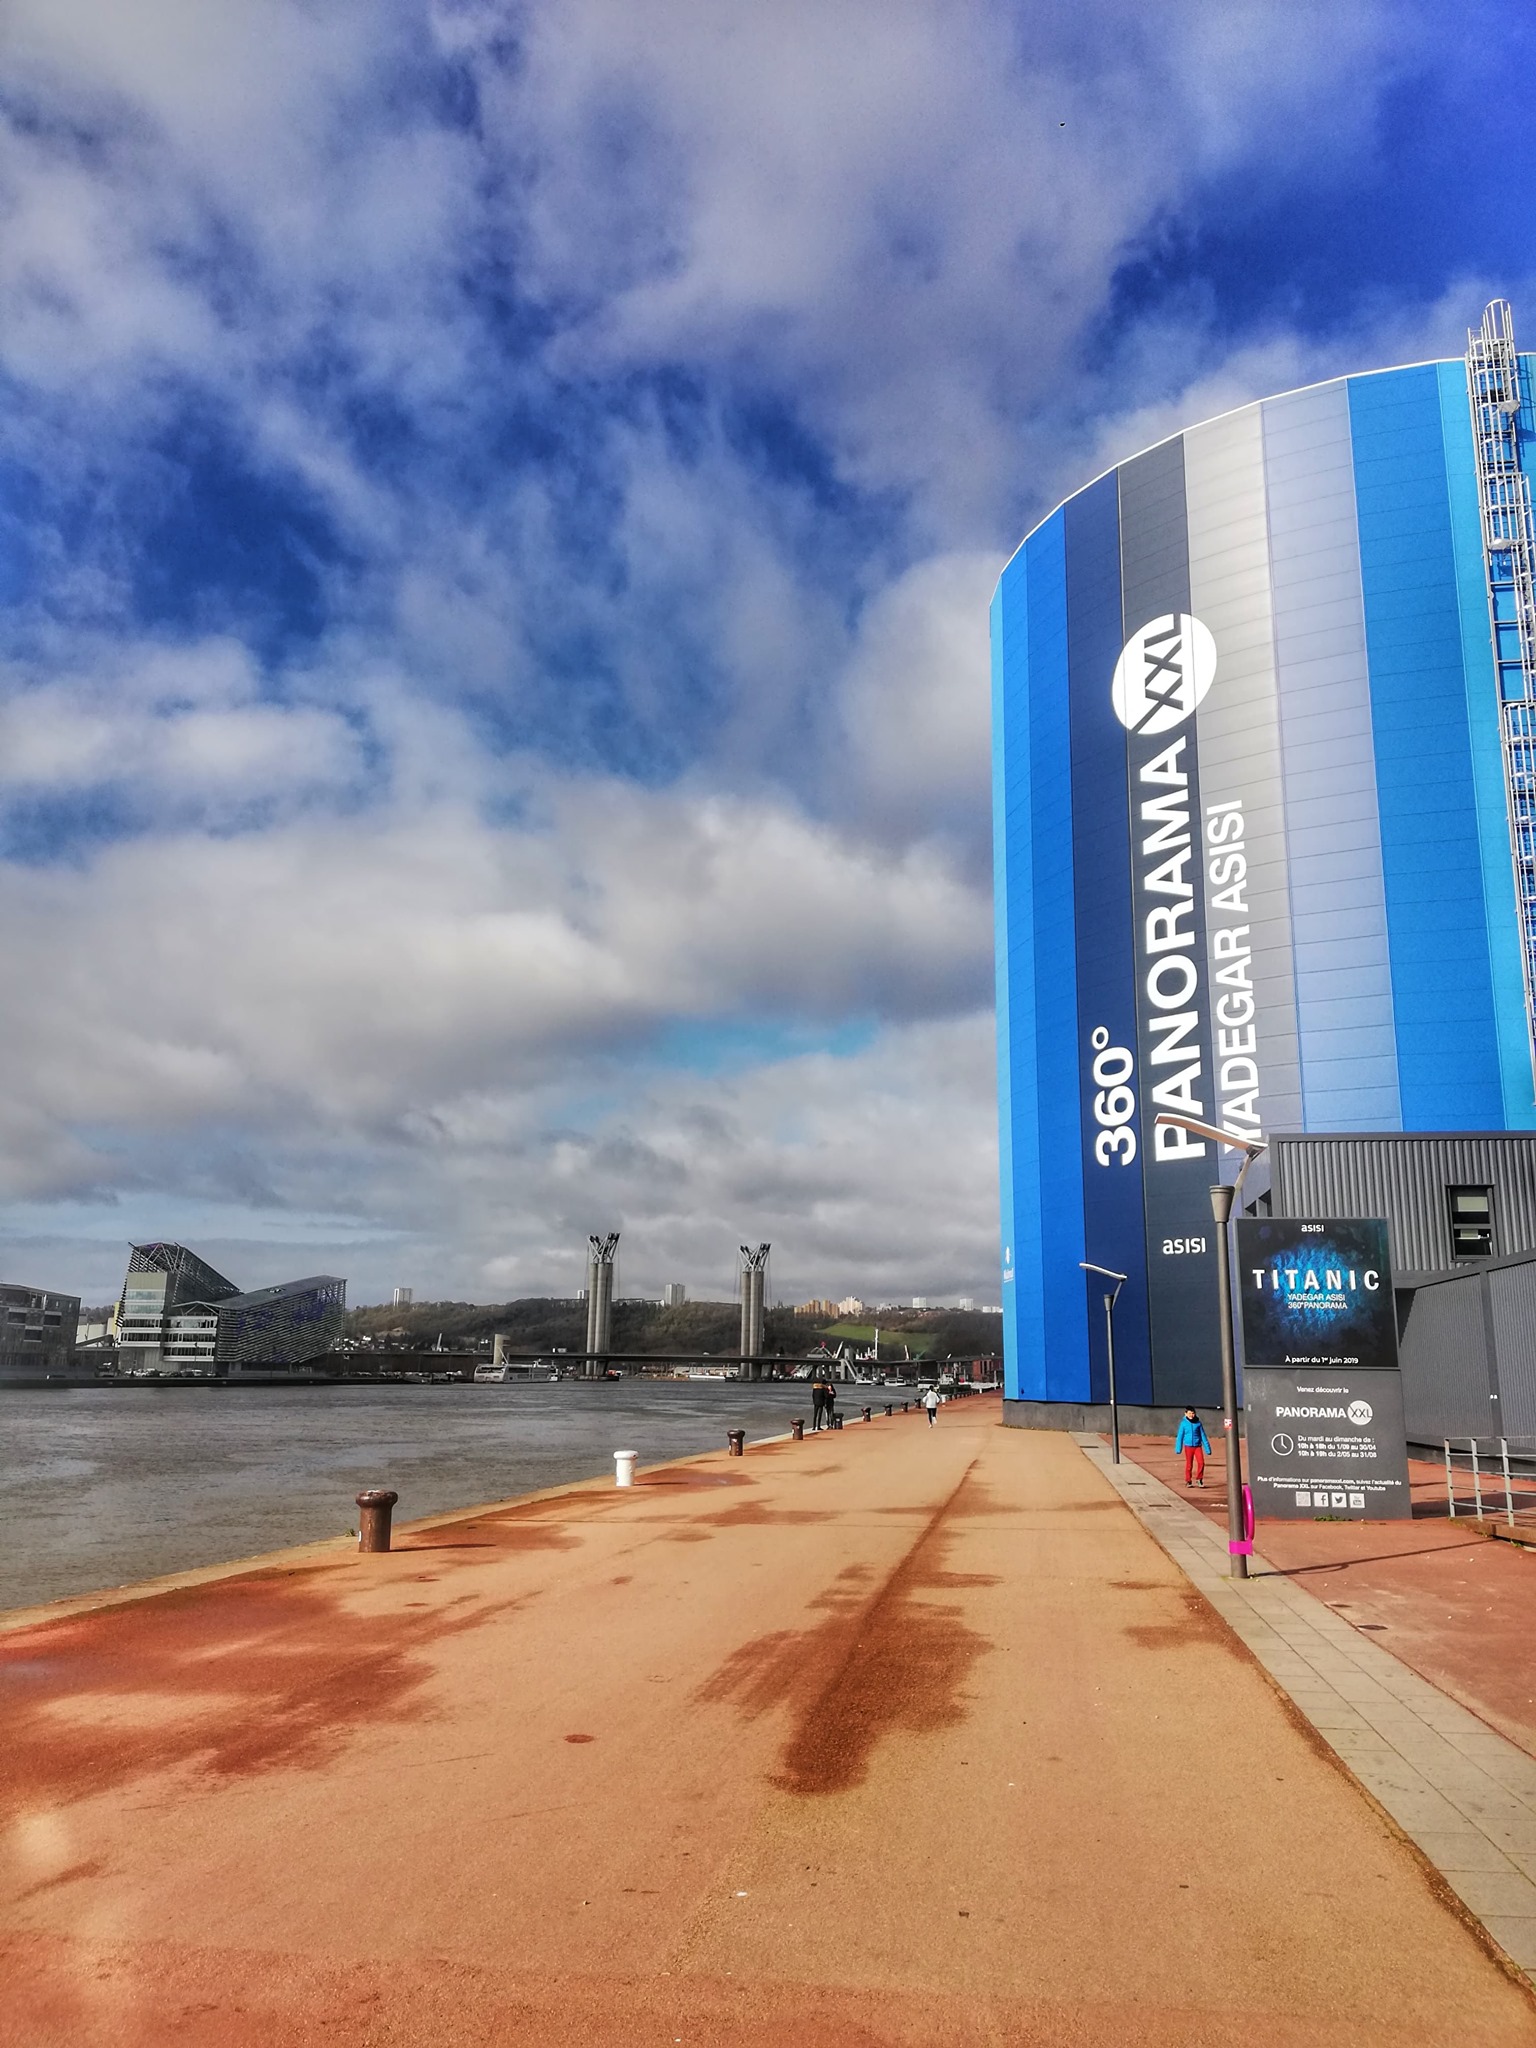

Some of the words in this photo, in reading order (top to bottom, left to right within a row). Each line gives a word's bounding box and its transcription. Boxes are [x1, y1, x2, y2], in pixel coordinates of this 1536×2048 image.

[1207, 800, 1249, 912] ASISI
[1140, 736, 1206, 1162] PANORAMA
[1091, 1026, 1137, 1167] 360°
[1301, 1224, 1324, 1232] asisi
[1162, 1237, 1206, 1255] asisi
[1252, 1269, 1380, 1291] TITANIC
[1287, 1293, 1325, 1301] YADEGAR
[1291, 1356, 1311, 1364] partir
[1276, 1406, 1347, 1418] PANORAMA
[1350, 1407, 1372, 1418] XXL
